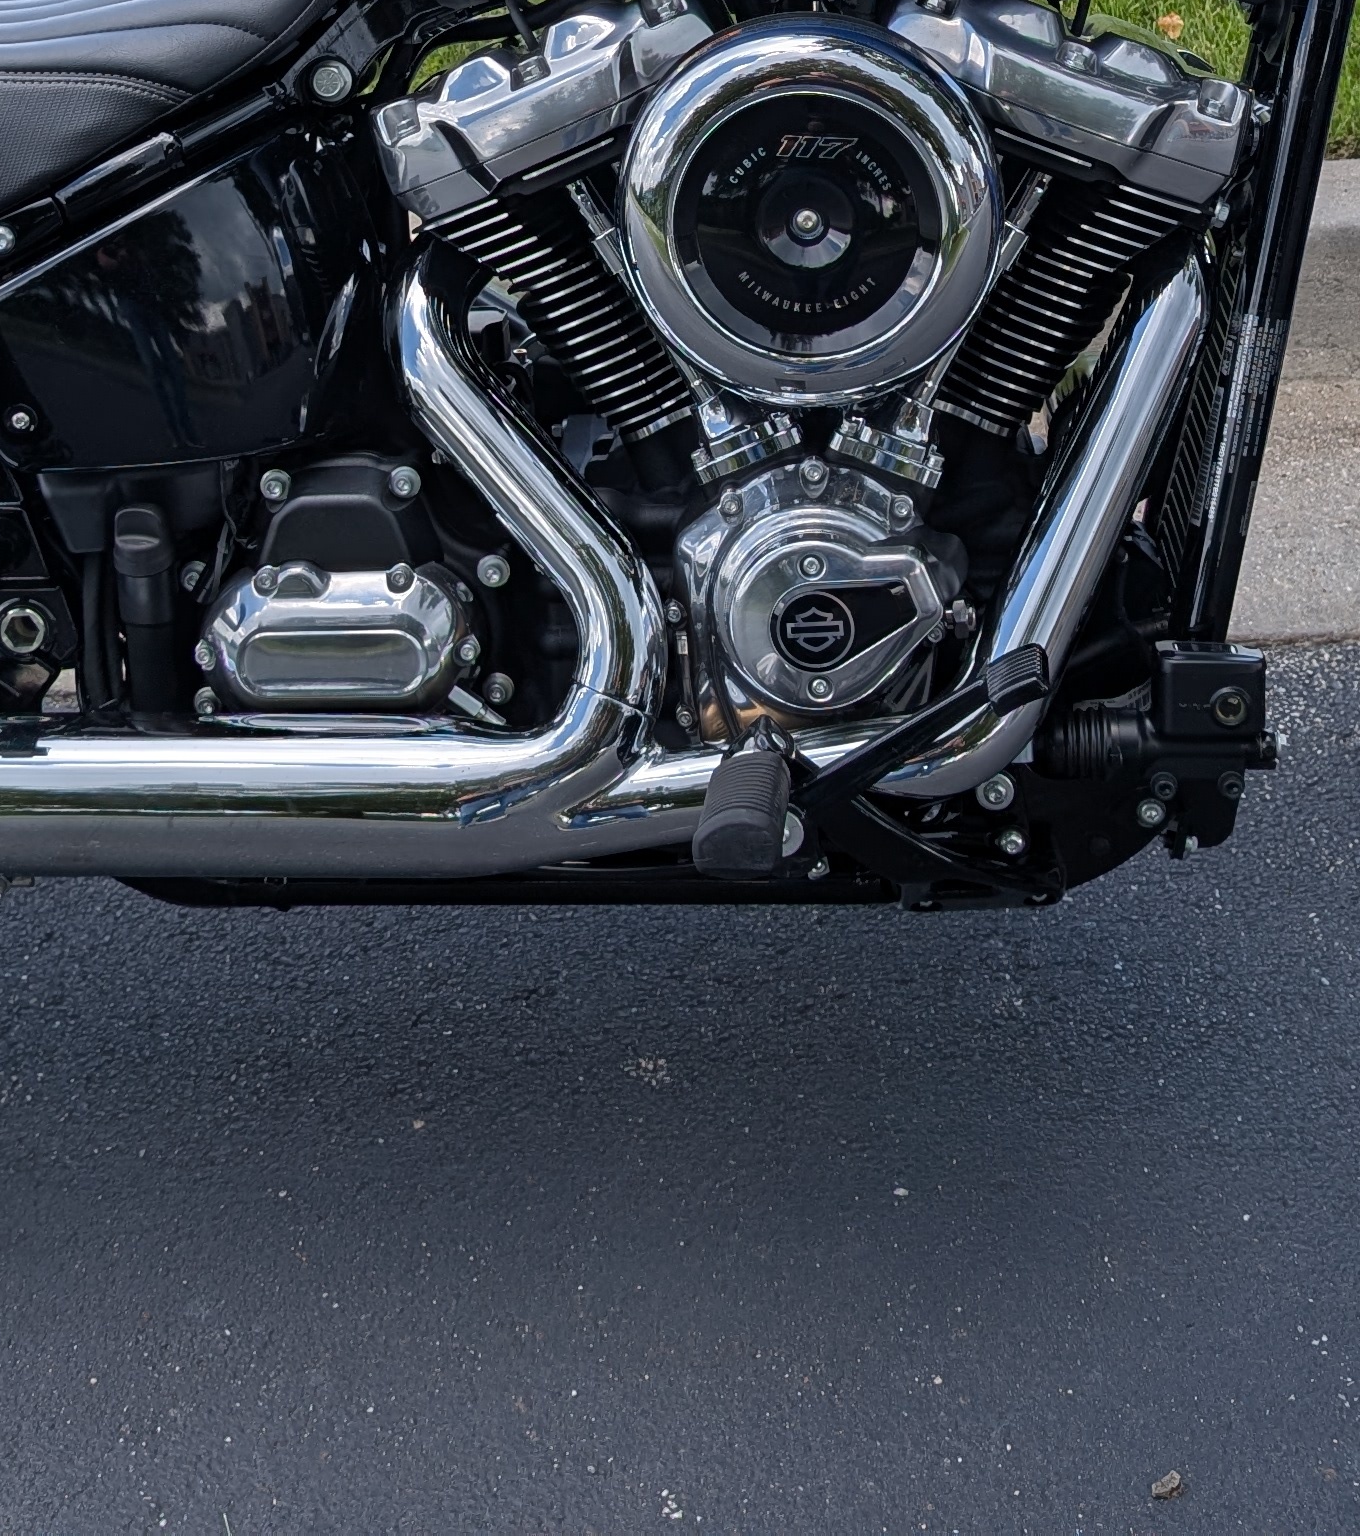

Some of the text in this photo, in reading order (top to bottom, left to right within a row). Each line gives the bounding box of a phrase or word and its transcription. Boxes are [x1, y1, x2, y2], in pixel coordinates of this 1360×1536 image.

[729, 134, 892, 191] CUBIC 117 INCHES
